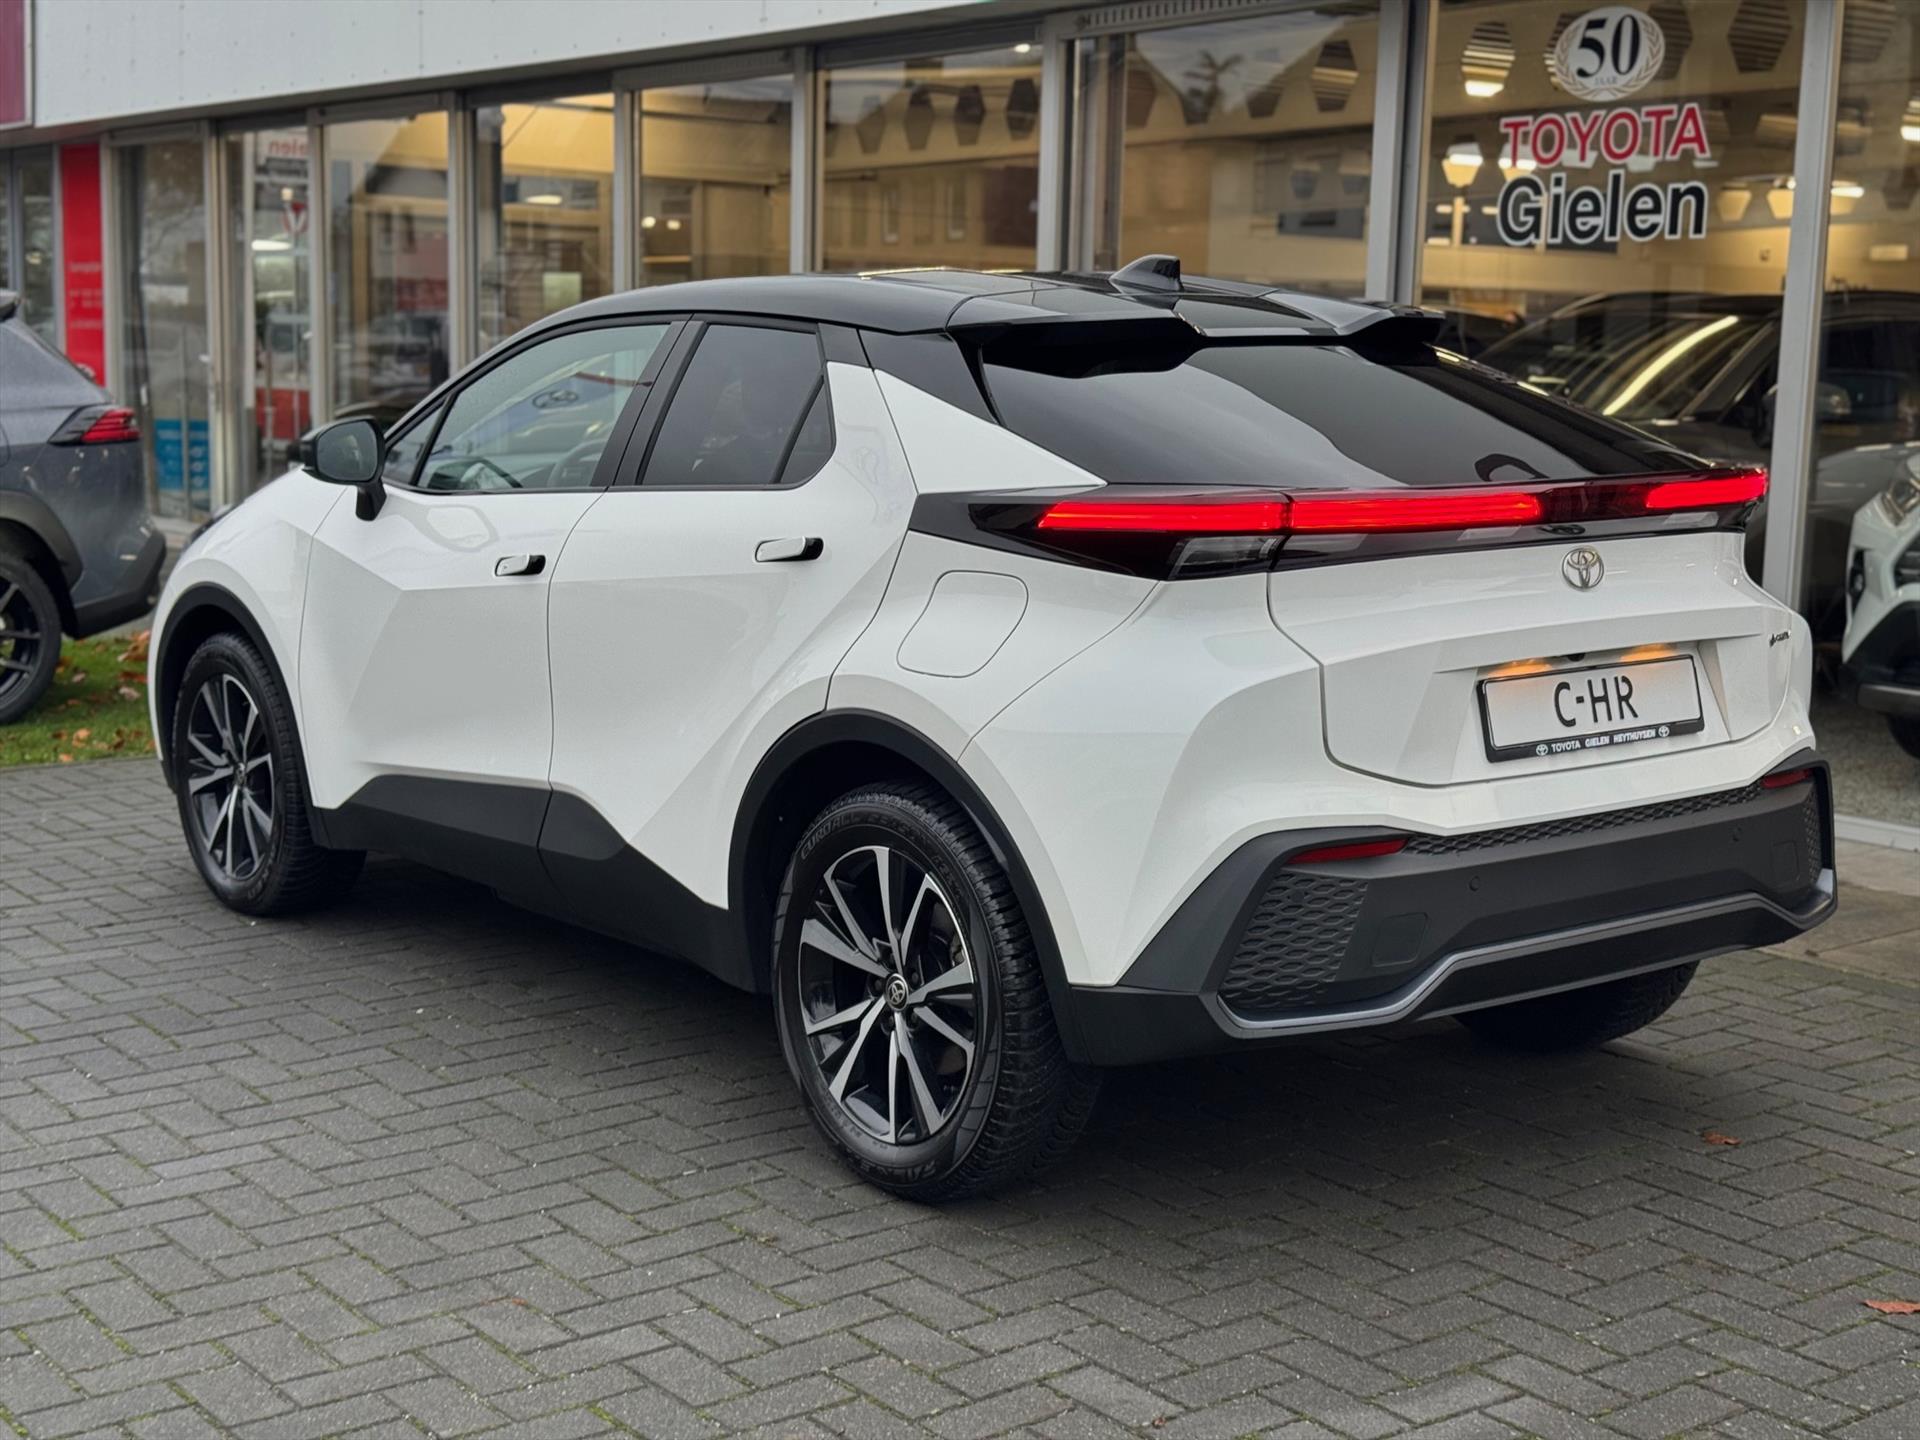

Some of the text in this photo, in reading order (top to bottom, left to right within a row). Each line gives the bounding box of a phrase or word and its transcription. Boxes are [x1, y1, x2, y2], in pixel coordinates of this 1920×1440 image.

[1576, 14, 1640, 78] 50
[1502, 105, 1709, 168] TOYOTA
[1498, 170, 1707, 245] Gielen
[1554, 675, 1639, 727] C-HR
[1551, 728, 1656, 753] TOYOTA GIELEN HEYTHUYSEN
